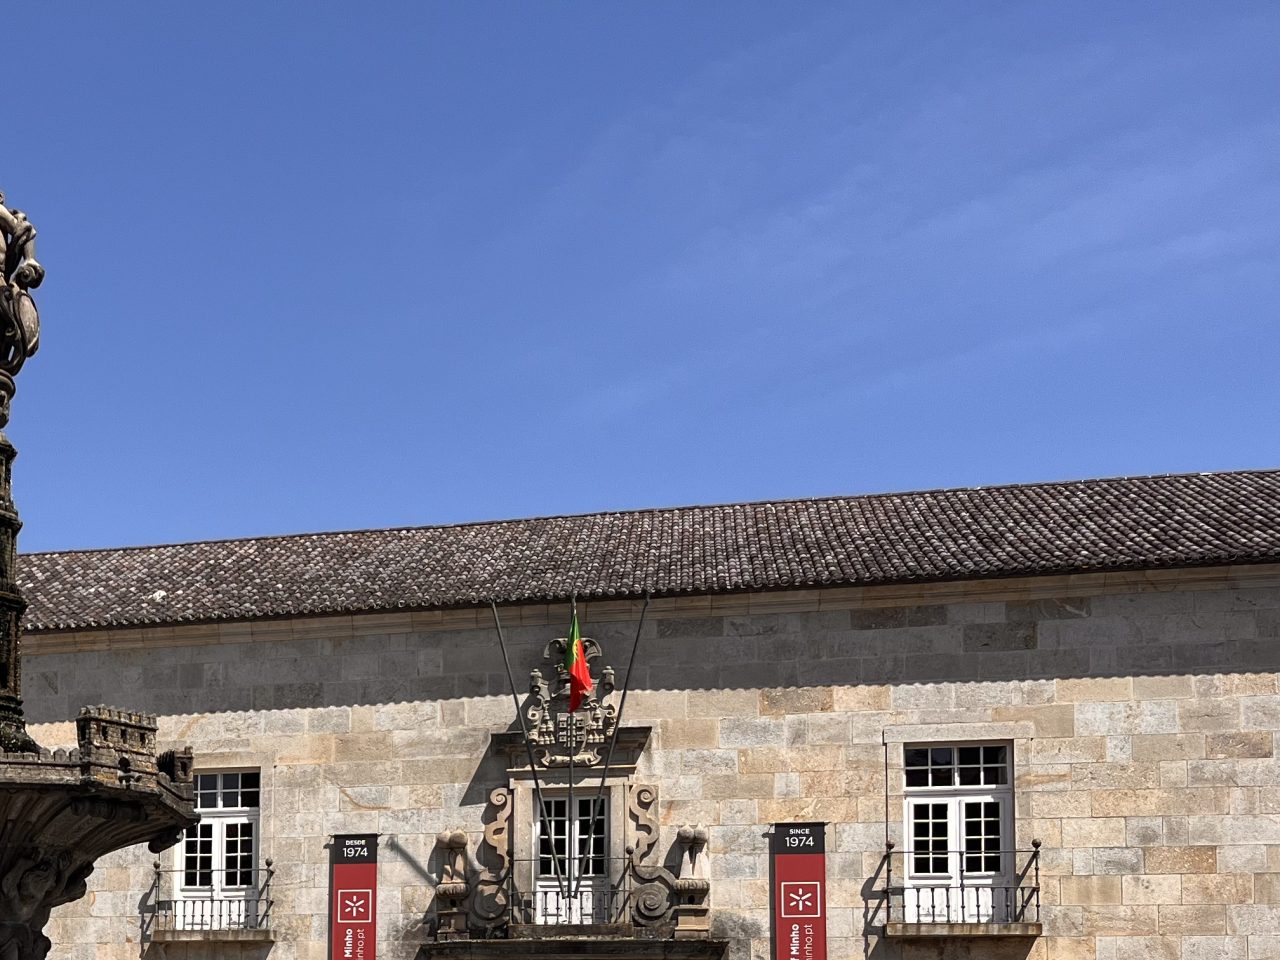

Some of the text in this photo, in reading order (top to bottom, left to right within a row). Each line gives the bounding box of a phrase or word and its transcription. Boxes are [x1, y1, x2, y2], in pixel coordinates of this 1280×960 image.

[784, 836, 814, 847] 1974
[342, 847, 368, 857] 1974
[343, 928, 353, 958] Minho
[790, 923, 799, 955] Minho
